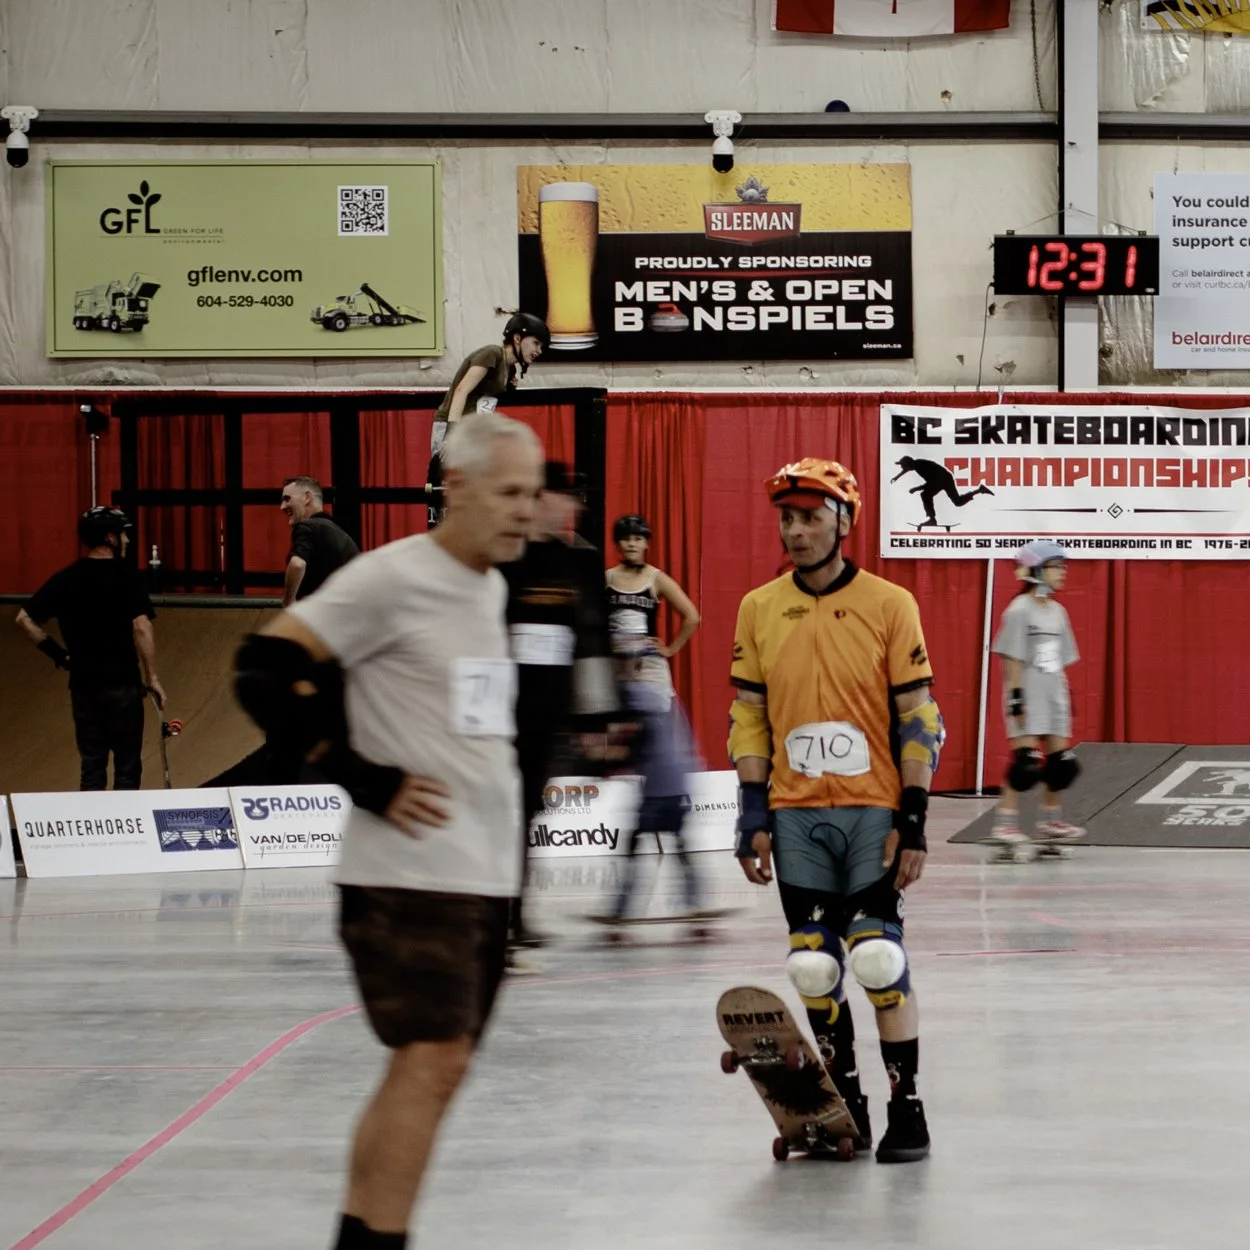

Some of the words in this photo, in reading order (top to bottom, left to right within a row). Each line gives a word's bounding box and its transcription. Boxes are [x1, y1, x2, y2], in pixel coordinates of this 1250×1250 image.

[1172, 196, 1202, 208] You
[1206, 196, 1250, 208] could
[100, 194, 161, 234] GFL
[711, 211, 794, 231] SLEEMAN
[1172, 215, 1248, 228] insurance
[1172, 236, 1235, 249] support
[634, 256, 735, 269] PROUDLY
[738, 255, 872, 268] SPONSORING
[1027, 242, 1137, 290] 12:31
[187, 266, 303, 287] gflenv.com
[1172, 270, 1188, 278] Call
[1191, 270, 1243, 278] belairdirect
[614, 280, 737, 302] MEN'S
[747, 280, 776, 301] &
[785, 279, 893, 300] OPEN
[1185, 281, 1201, 289] visit
[196, 295, 294, 308] 604-529-4030
[614, 303, 895, 332] BNSPIELS
[891, 414, 942, 444] BC
[890, 538, 972, 548] CELEBRATING
[975, 539, 991, 548] 50
[1057, 539, 1157, 549] SKATEBOARDING
[1160, 539, 1172, 549] IN
[1175, 539, 1192, 549] BC
[796, 733, 853, 759] 710
[269, 796, 342, 812] RADIUS
[543, 785, 600, 808] ORP
[25, 817, 145, 838] QUARTERHORSE
[1162, 817, 1248, 826] YEARS
[528, 823, 620, 850] ullcandy
[722, 1011, 784, 1026] REVERT
